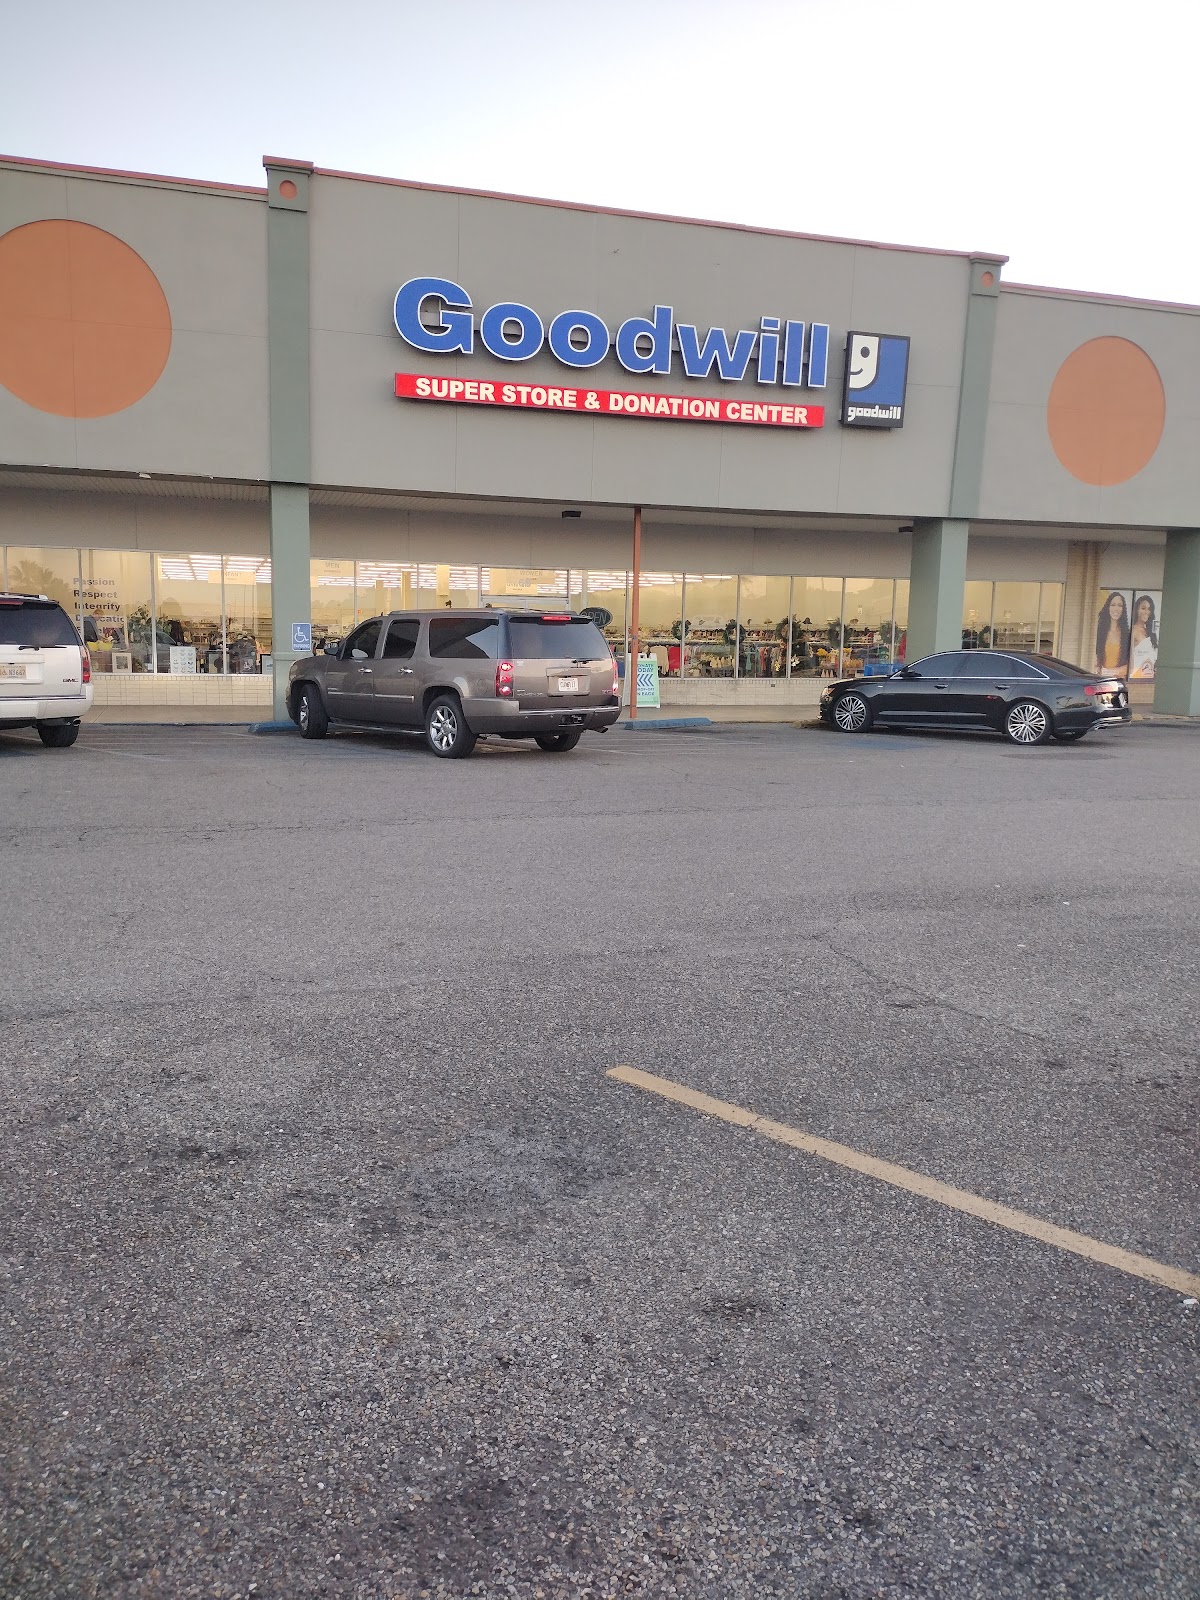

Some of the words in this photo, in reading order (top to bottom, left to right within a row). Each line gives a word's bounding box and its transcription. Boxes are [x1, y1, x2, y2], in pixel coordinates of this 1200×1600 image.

[394, 277, 829, 387] Goodwill
[415, 377, 495, 401] SUPER
[502, 385, 577, 408] STORE
[584, 392, 601, 409] &
[609, 393, 720, 418] DONATION
[726, 402, 808, 424] CENTER
[847, 405, 902, 421] goodwill
[73, 577, 115, 586] Passion
[73, 589, 118, 599] Respect
[74, 602, 121, 612] Integrity
